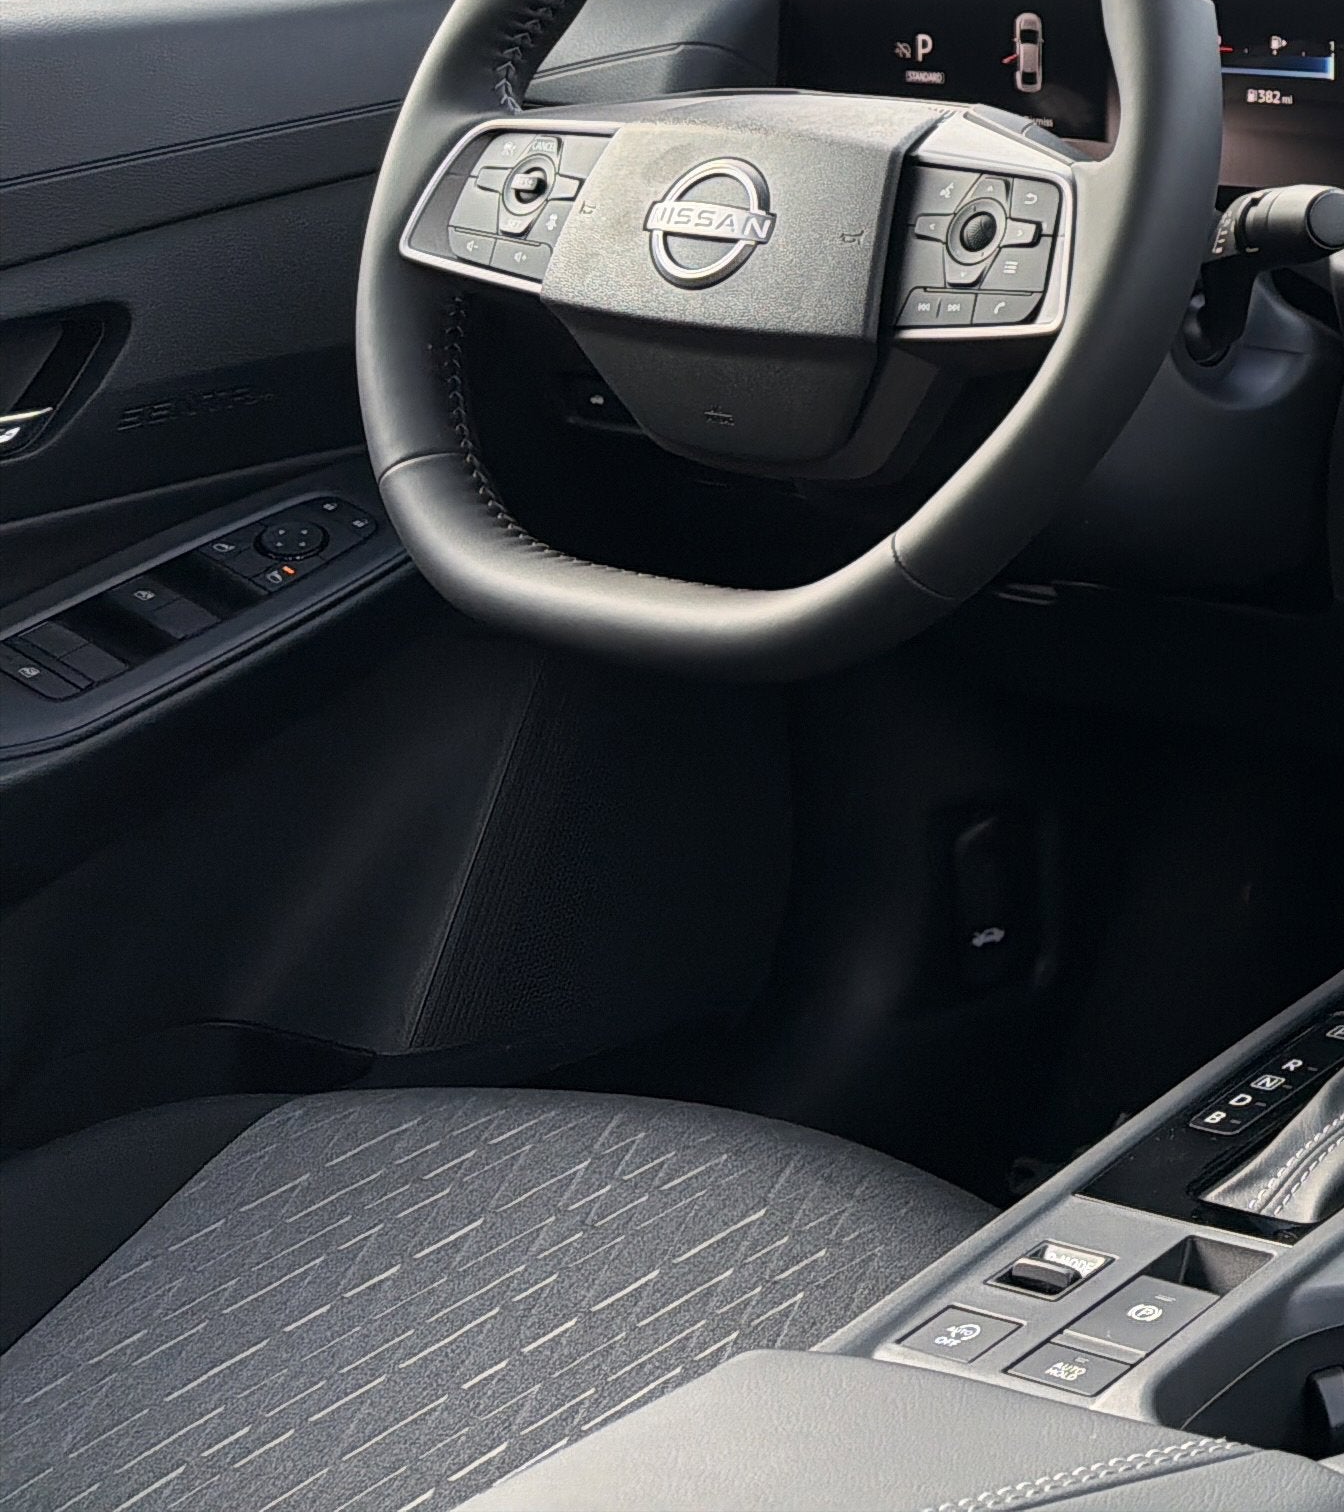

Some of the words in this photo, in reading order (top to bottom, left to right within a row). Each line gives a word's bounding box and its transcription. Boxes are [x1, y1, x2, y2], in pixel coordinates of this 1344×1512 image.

[915, 34, 933, 62] P
[908, 72, 942, 83] STANDARD
[1257, 90, 1280, 104] 382
[1282, 95, 1293, 104] mi
[656, 203, 776, 244] NISSAN
[1282, 1059, 1303, 1071] R
[1259, 1077, 1277, 1087] N
[1229, 1093, 1252, 1106] D
[1204, 1111, 1226, 1124] B
[946, 1326, 973, 1337] AUTO
[935, 1336, 961, 1347] OFF
[1045, 1368, 1079, 1380] HOLD
[1057, 1362, 1086, 1376] AUTO
